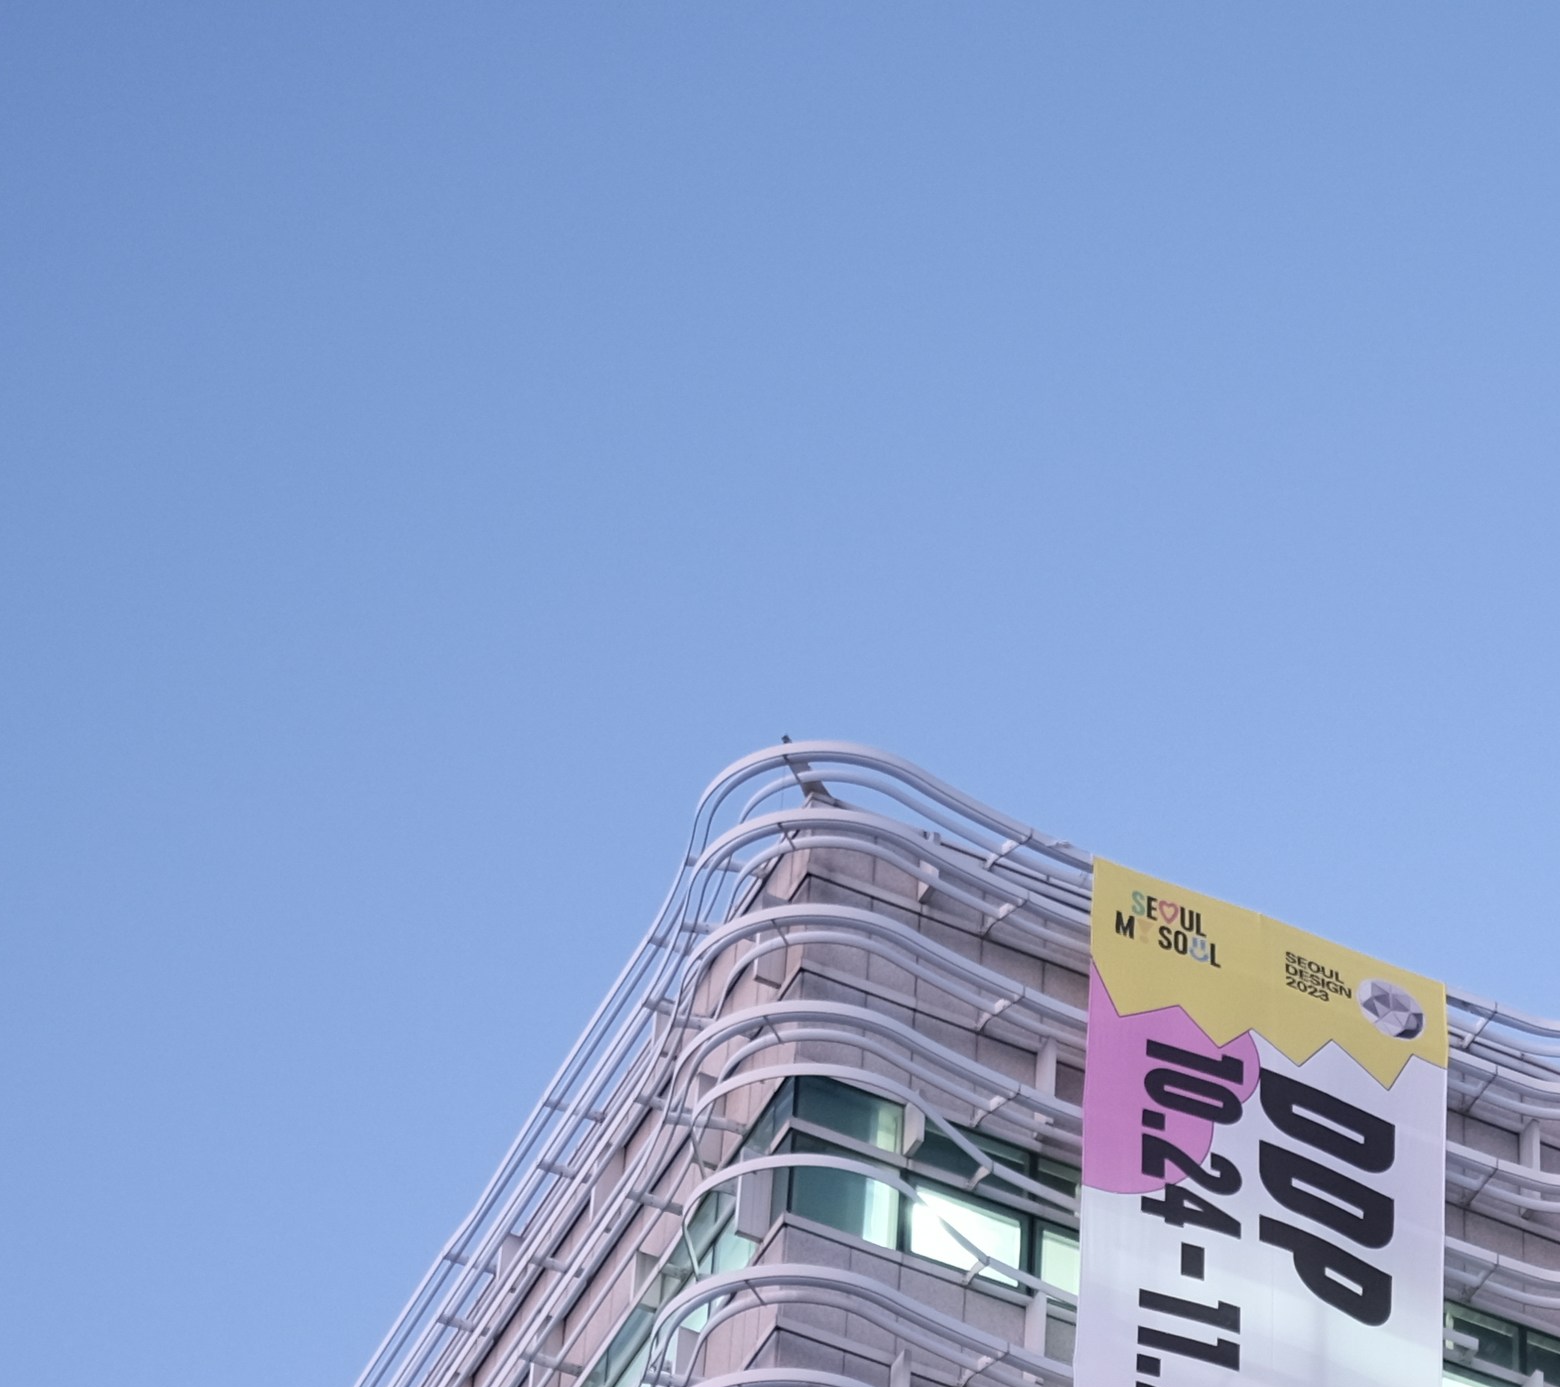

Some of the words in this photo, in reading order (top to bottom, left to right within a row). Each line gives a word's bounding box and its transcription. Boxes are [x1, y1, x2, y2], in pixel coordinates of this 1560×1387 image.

[1285, 951, 1344, 985] SEOUL
[1285, 963, 1352, 999] DESIGN
[1285, 976, 1330, 1002] 2023
[1259, 1067, 1396, 1327] DDP
